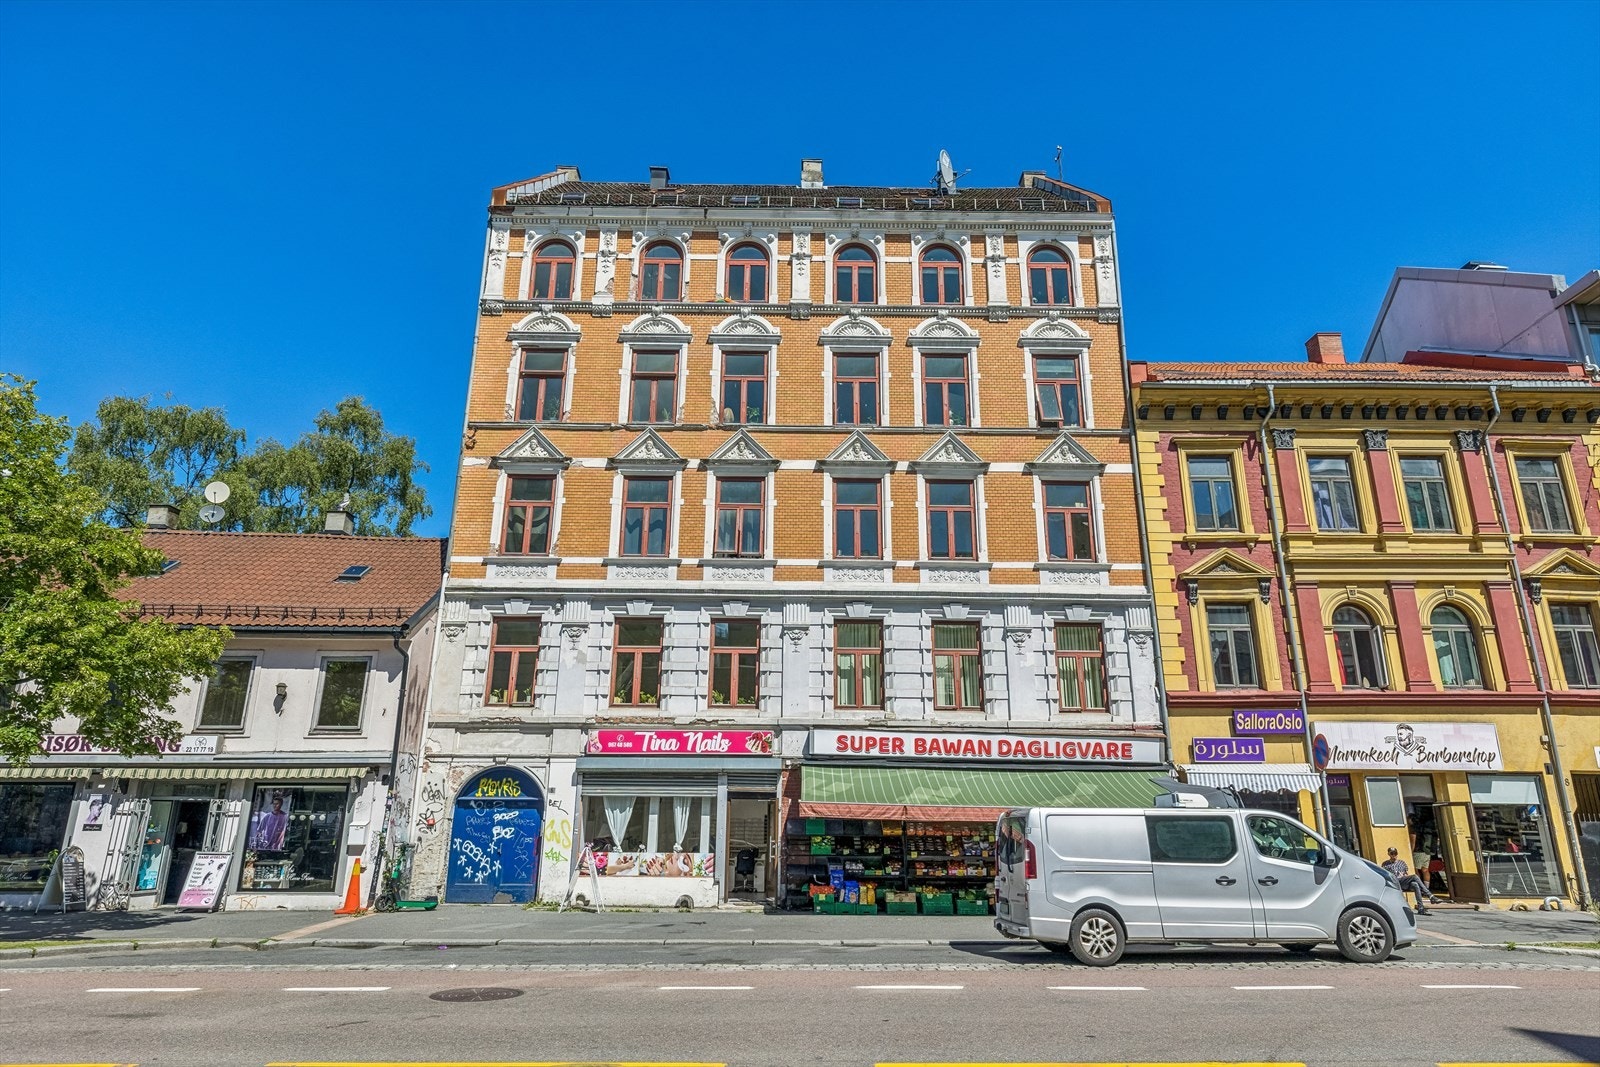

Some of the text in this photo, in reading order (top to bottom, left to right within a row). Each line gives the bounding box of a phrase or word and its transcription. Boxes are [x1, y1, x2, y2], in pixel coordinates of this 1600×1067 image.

[1236, 713, 1302, 730] SalloraOslo
[634, 731, 732, 753] Tina Nails
[836, 734, 1133, 761] SUPER BAWAN DAGLIGVARE
[1195, 741, 1260, 759] سلورة
[1416, 745, 1496, 769] Barbershop
